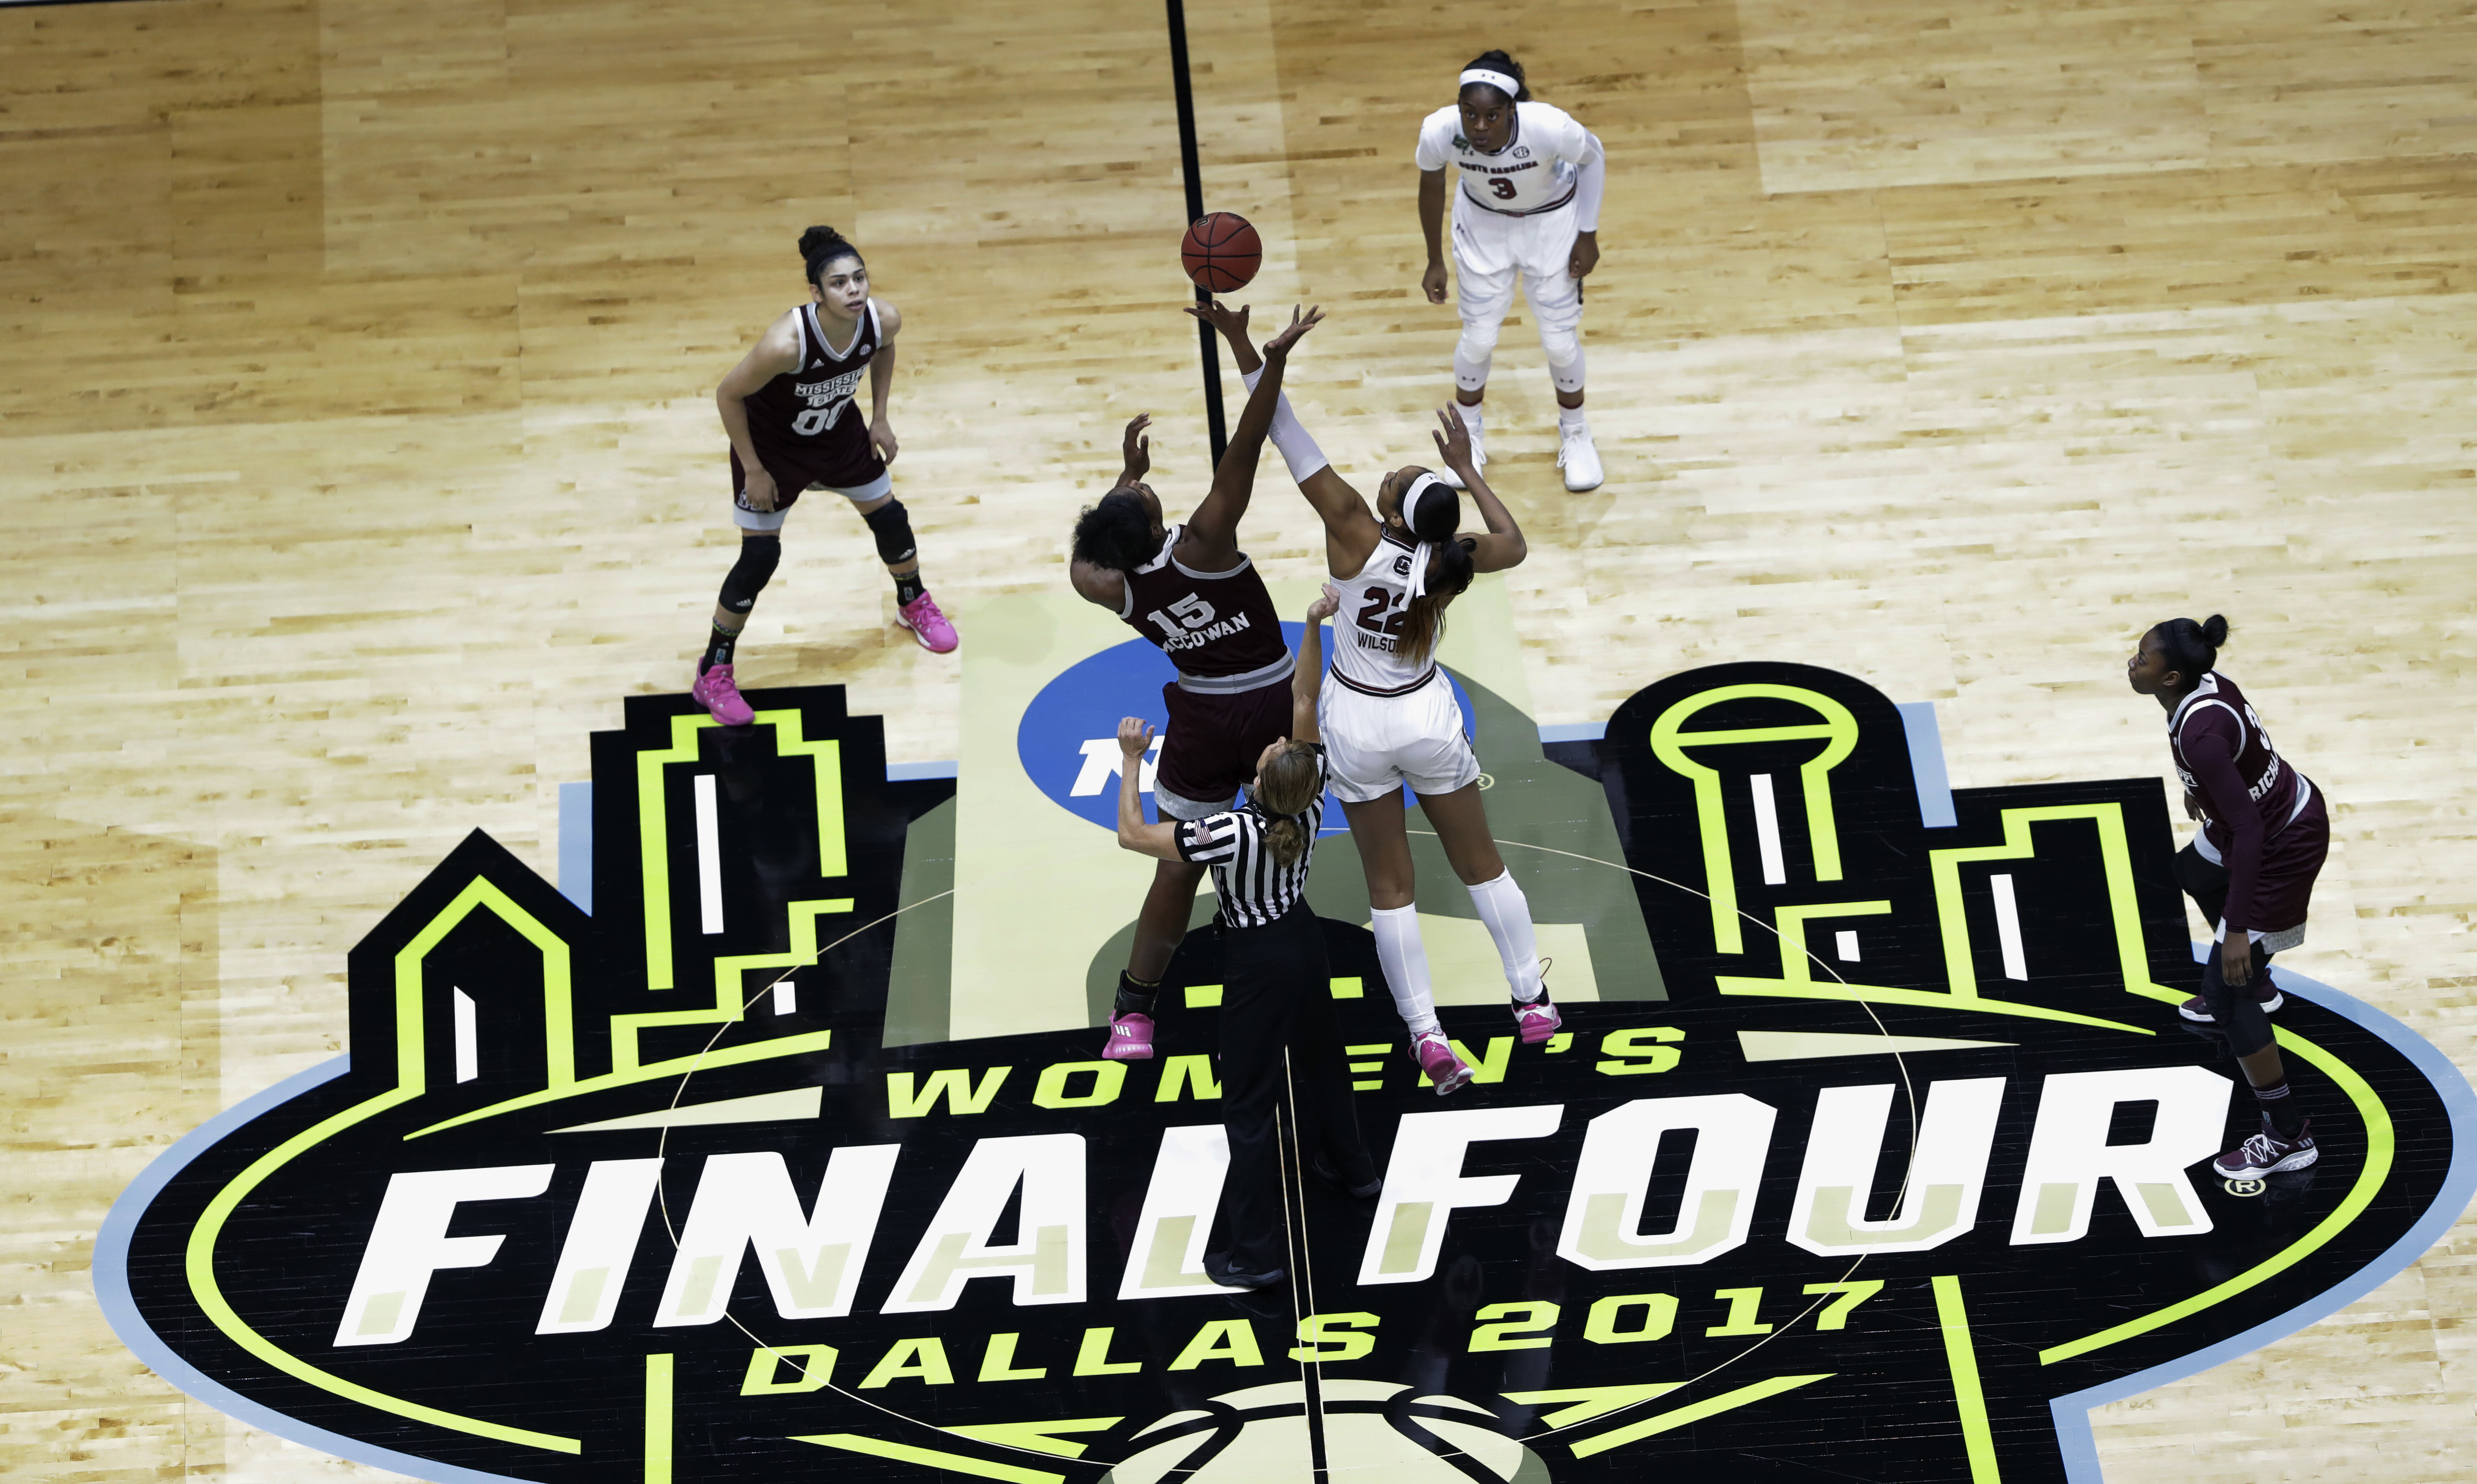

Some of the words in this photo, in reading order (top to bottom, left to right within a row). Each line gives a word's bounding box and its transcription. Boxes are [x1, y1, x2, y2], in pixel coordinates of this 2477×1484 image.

[1488, 177, 1517, 200] 3
[816, 385, 853, 405] STATE
[1147, 592, 1216, 637] 15
[1161, 611, 1250, 654] MCCOWAN
[1356, 586, 1405, 635] 22
[1358, 631, 1398, 653] WILSO
[2248, 752, 2279, 802] RICHA
[887, 1027, 1685, 1119] WOMEN'S
[333, 1124, 1268, 1347] FINAL
[1357, 1066, 2234, 1286] FOUR
[740, 1312, 1380, 1396] DALLAS
[1468, 1280, 1885, 1354] 2017
